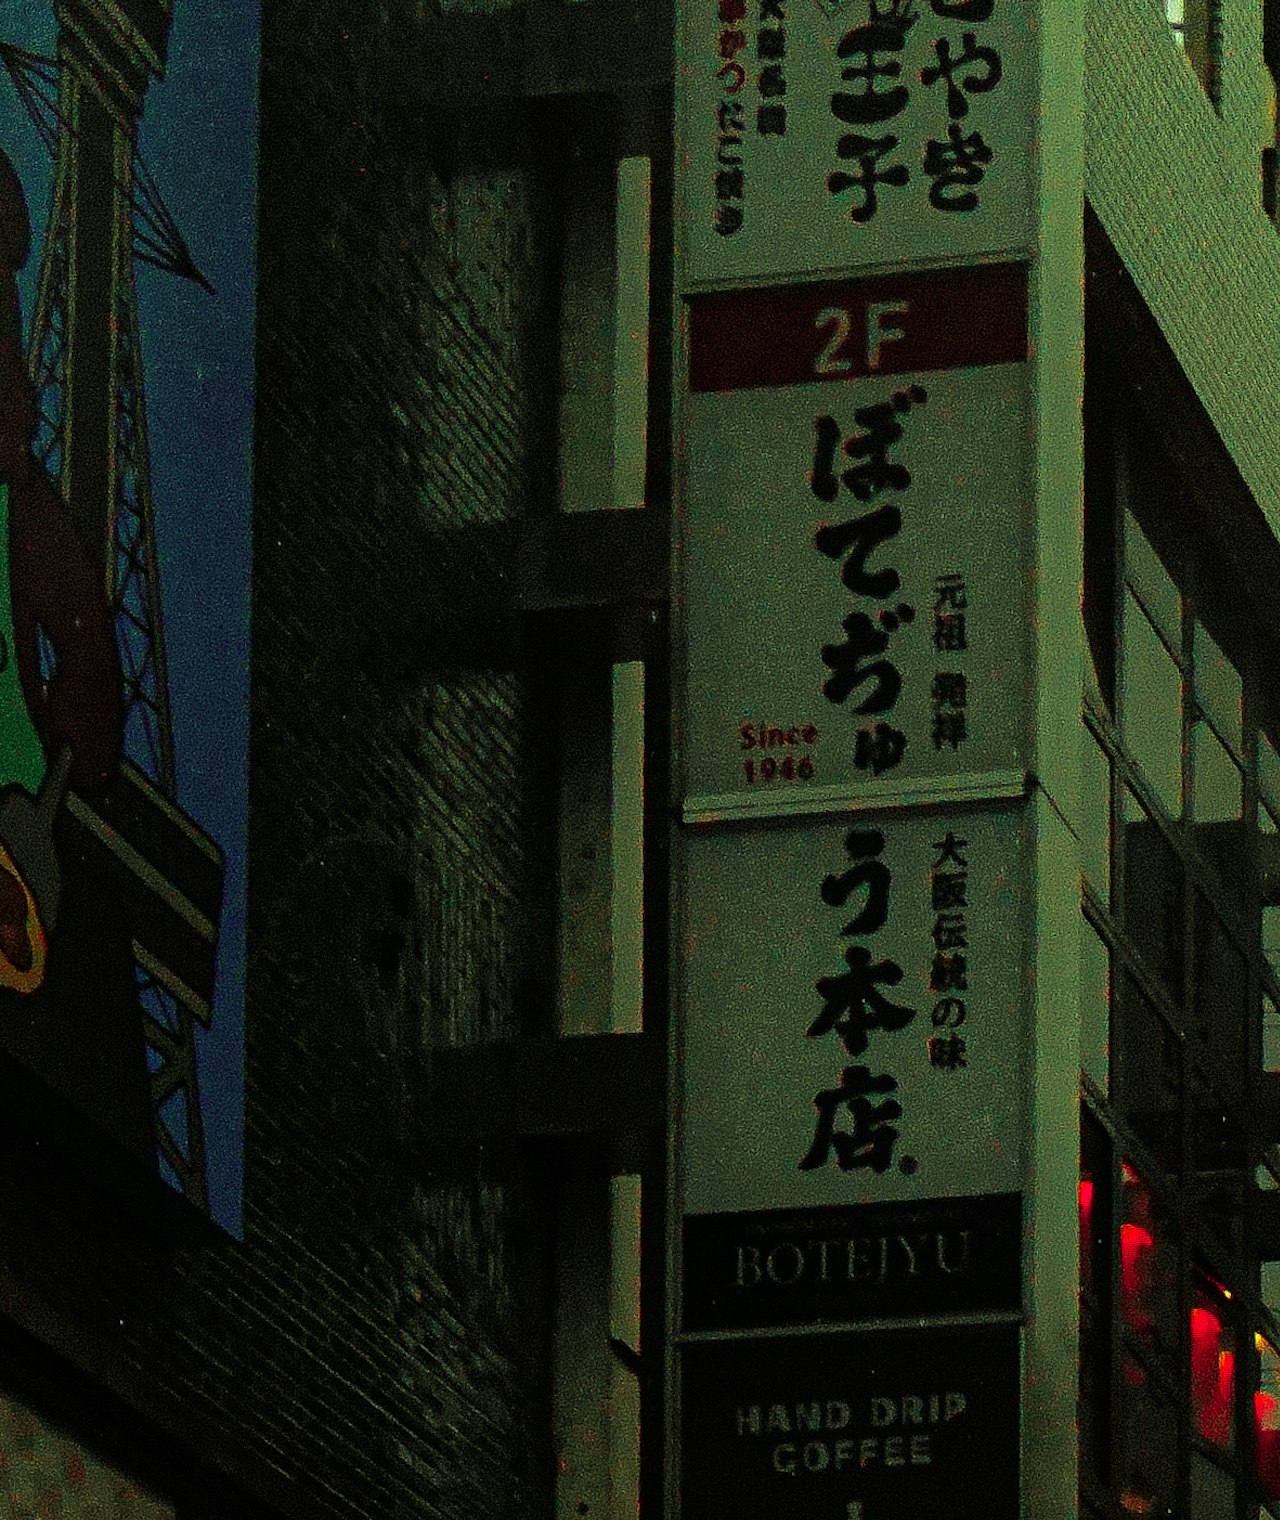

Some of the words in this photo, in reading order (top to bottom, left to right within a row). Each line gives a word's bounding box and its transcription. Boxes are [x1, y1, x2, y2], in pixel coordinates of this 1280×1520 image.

[813, 298, 911, 376] 2F
[740, 723, 817, 750] Since
[930, 832, 970, 1071] 大阪伝統の味
[733, 1230, 971, 1287] BOTEJYU
[737, 1401, 851, 1437] HAND
[870, 1392, 968, 1427] DRIP
[771, 1435, 932, 1474] COFFEE
